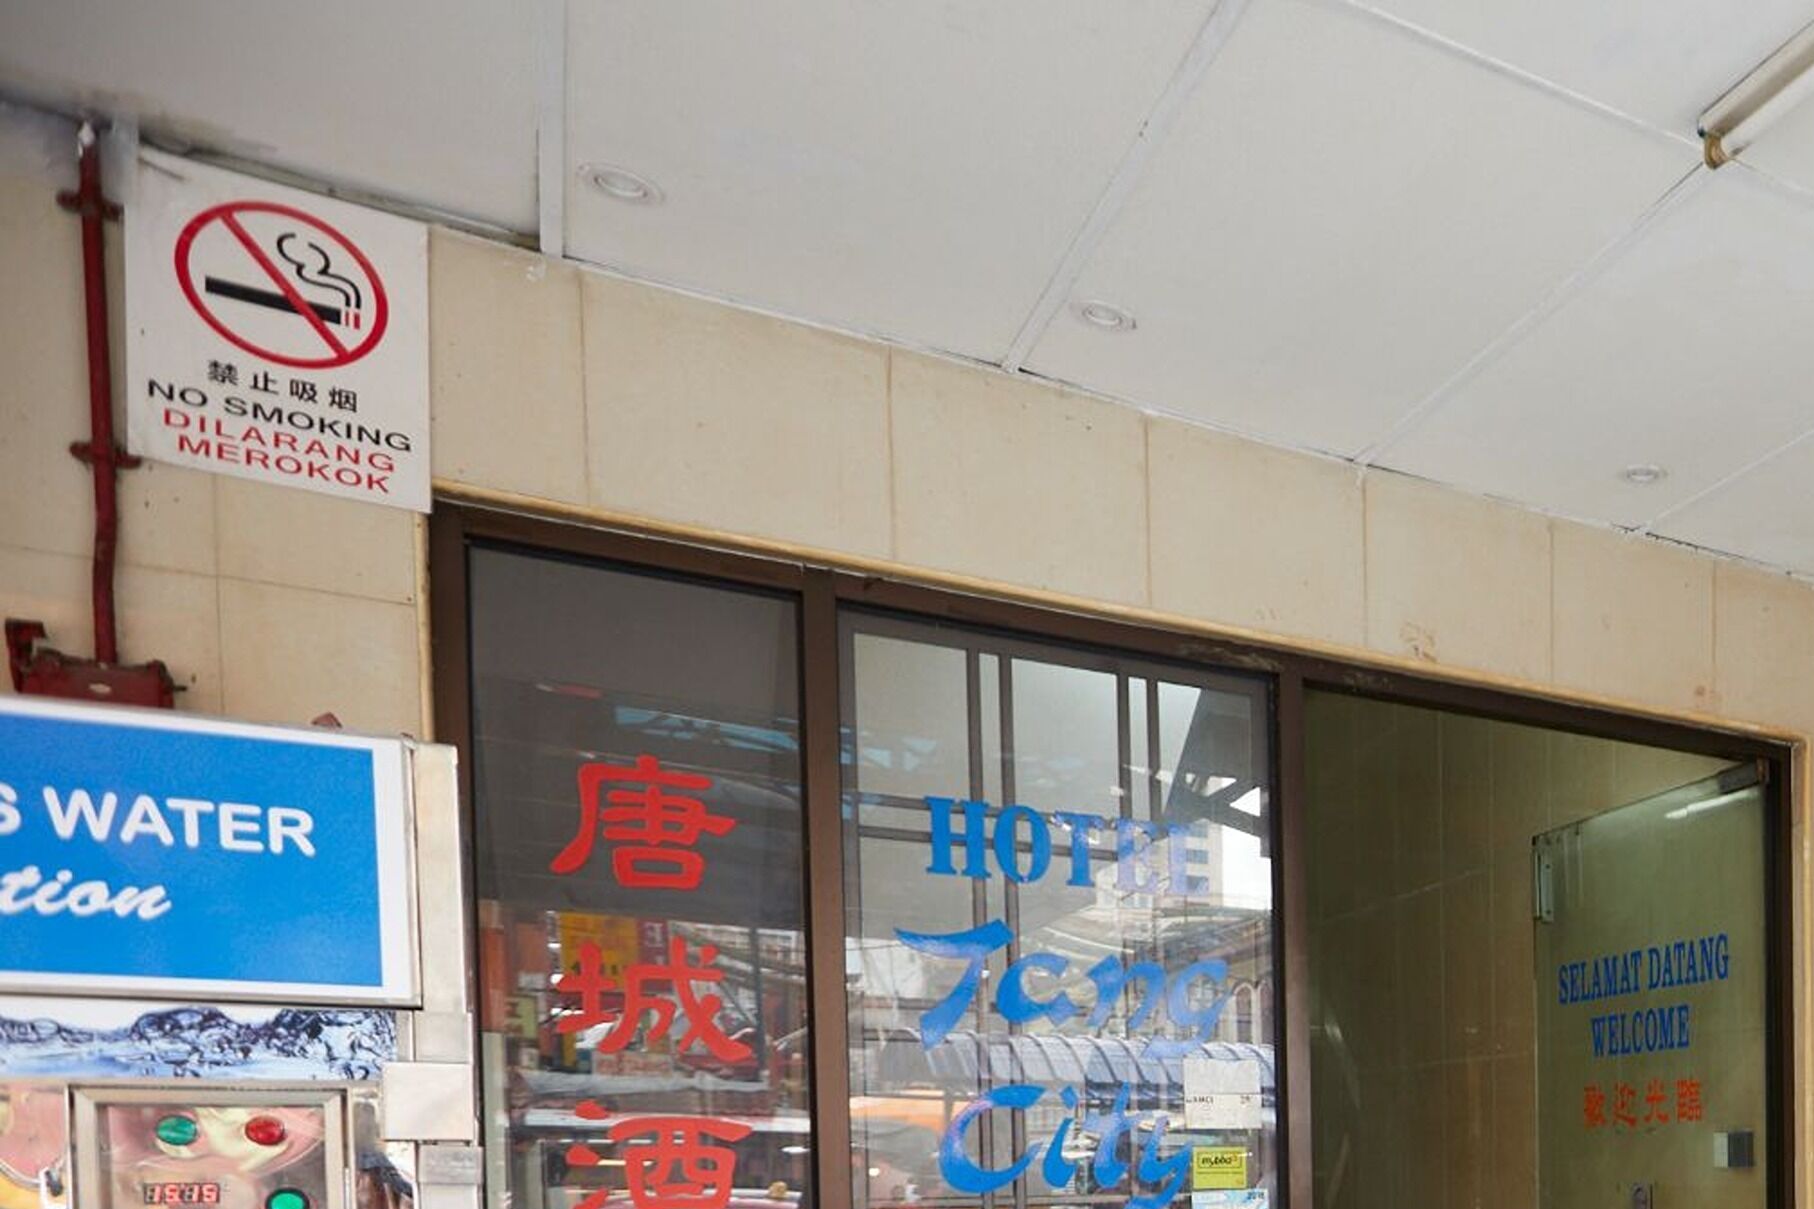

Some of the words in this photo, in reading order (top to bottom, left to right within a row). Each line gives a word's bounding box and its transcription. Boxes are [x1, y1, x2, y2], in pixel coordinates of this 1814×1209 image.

[149, 380, 208, 408] NO
[224, 396, 412, 451] SMOKING
[208, 360, 358, 413] 禁止吸烟
[163, 408, 395, 473] DILARANG
[178, 434, 390, 493] MEROKOK
[43, 786, 316, 857] WATER
[924, 796, 1210, 896] HOTEL
[893, 919, 1230, 1058] Tang
[1558, 948, 1643, 1005] SELAMAT
[1647, 934, 1730, 991] DATANG
[1591, 1004, 1691, 1058] WELCOME
